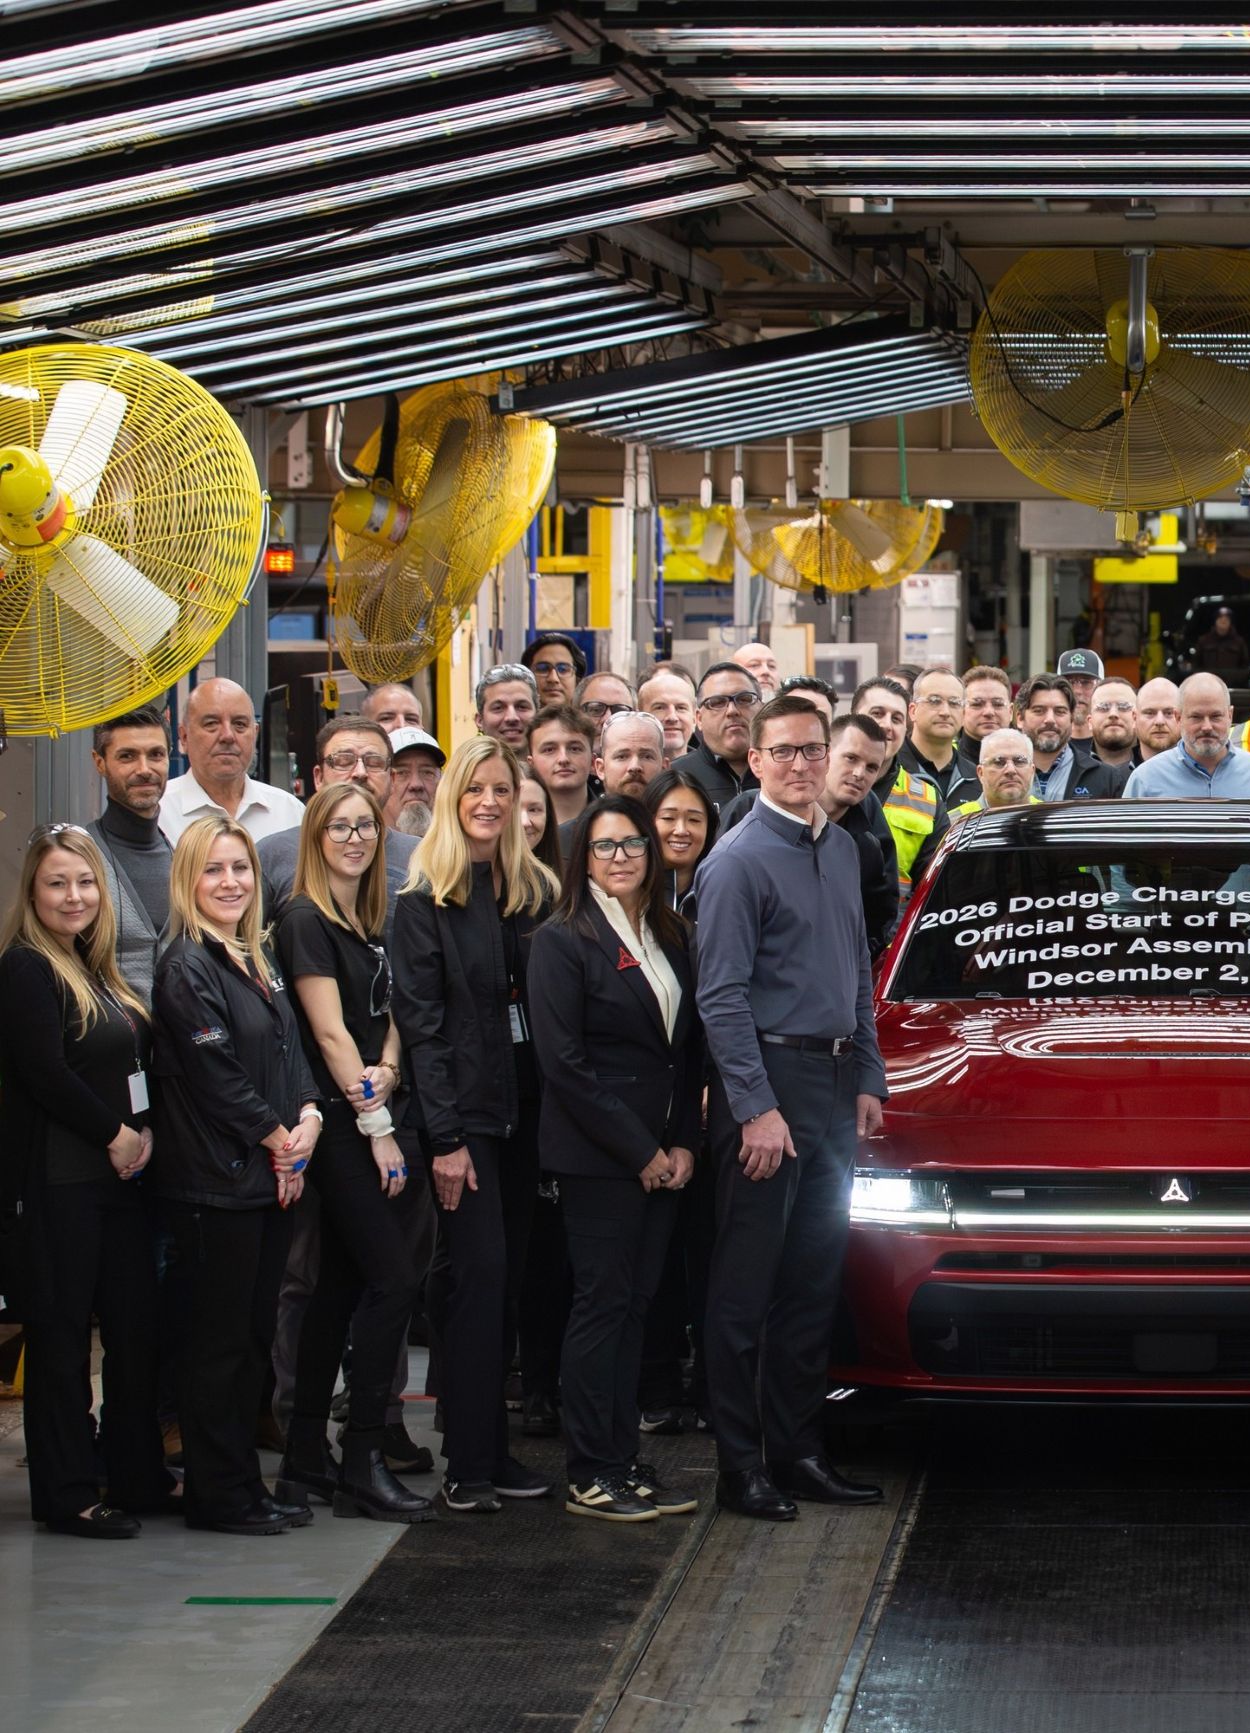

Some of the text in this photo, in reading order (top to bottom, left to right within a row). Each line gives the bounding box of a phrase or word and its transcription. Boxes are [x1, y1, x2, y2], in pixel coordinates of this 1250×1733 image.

[919, 902, 998, 930] 2026
[1008, 891, 1120, 913] Dodge
[954, 916, 1074, 946] Official
[1085, 911, 1172, 930] Start
[1184, 912, 1219, 927] of
[974, 940, 1118, 969] Windsor
[1028, 964, 1209, 989] December
[1219, 964, 1249, 984] 2,
